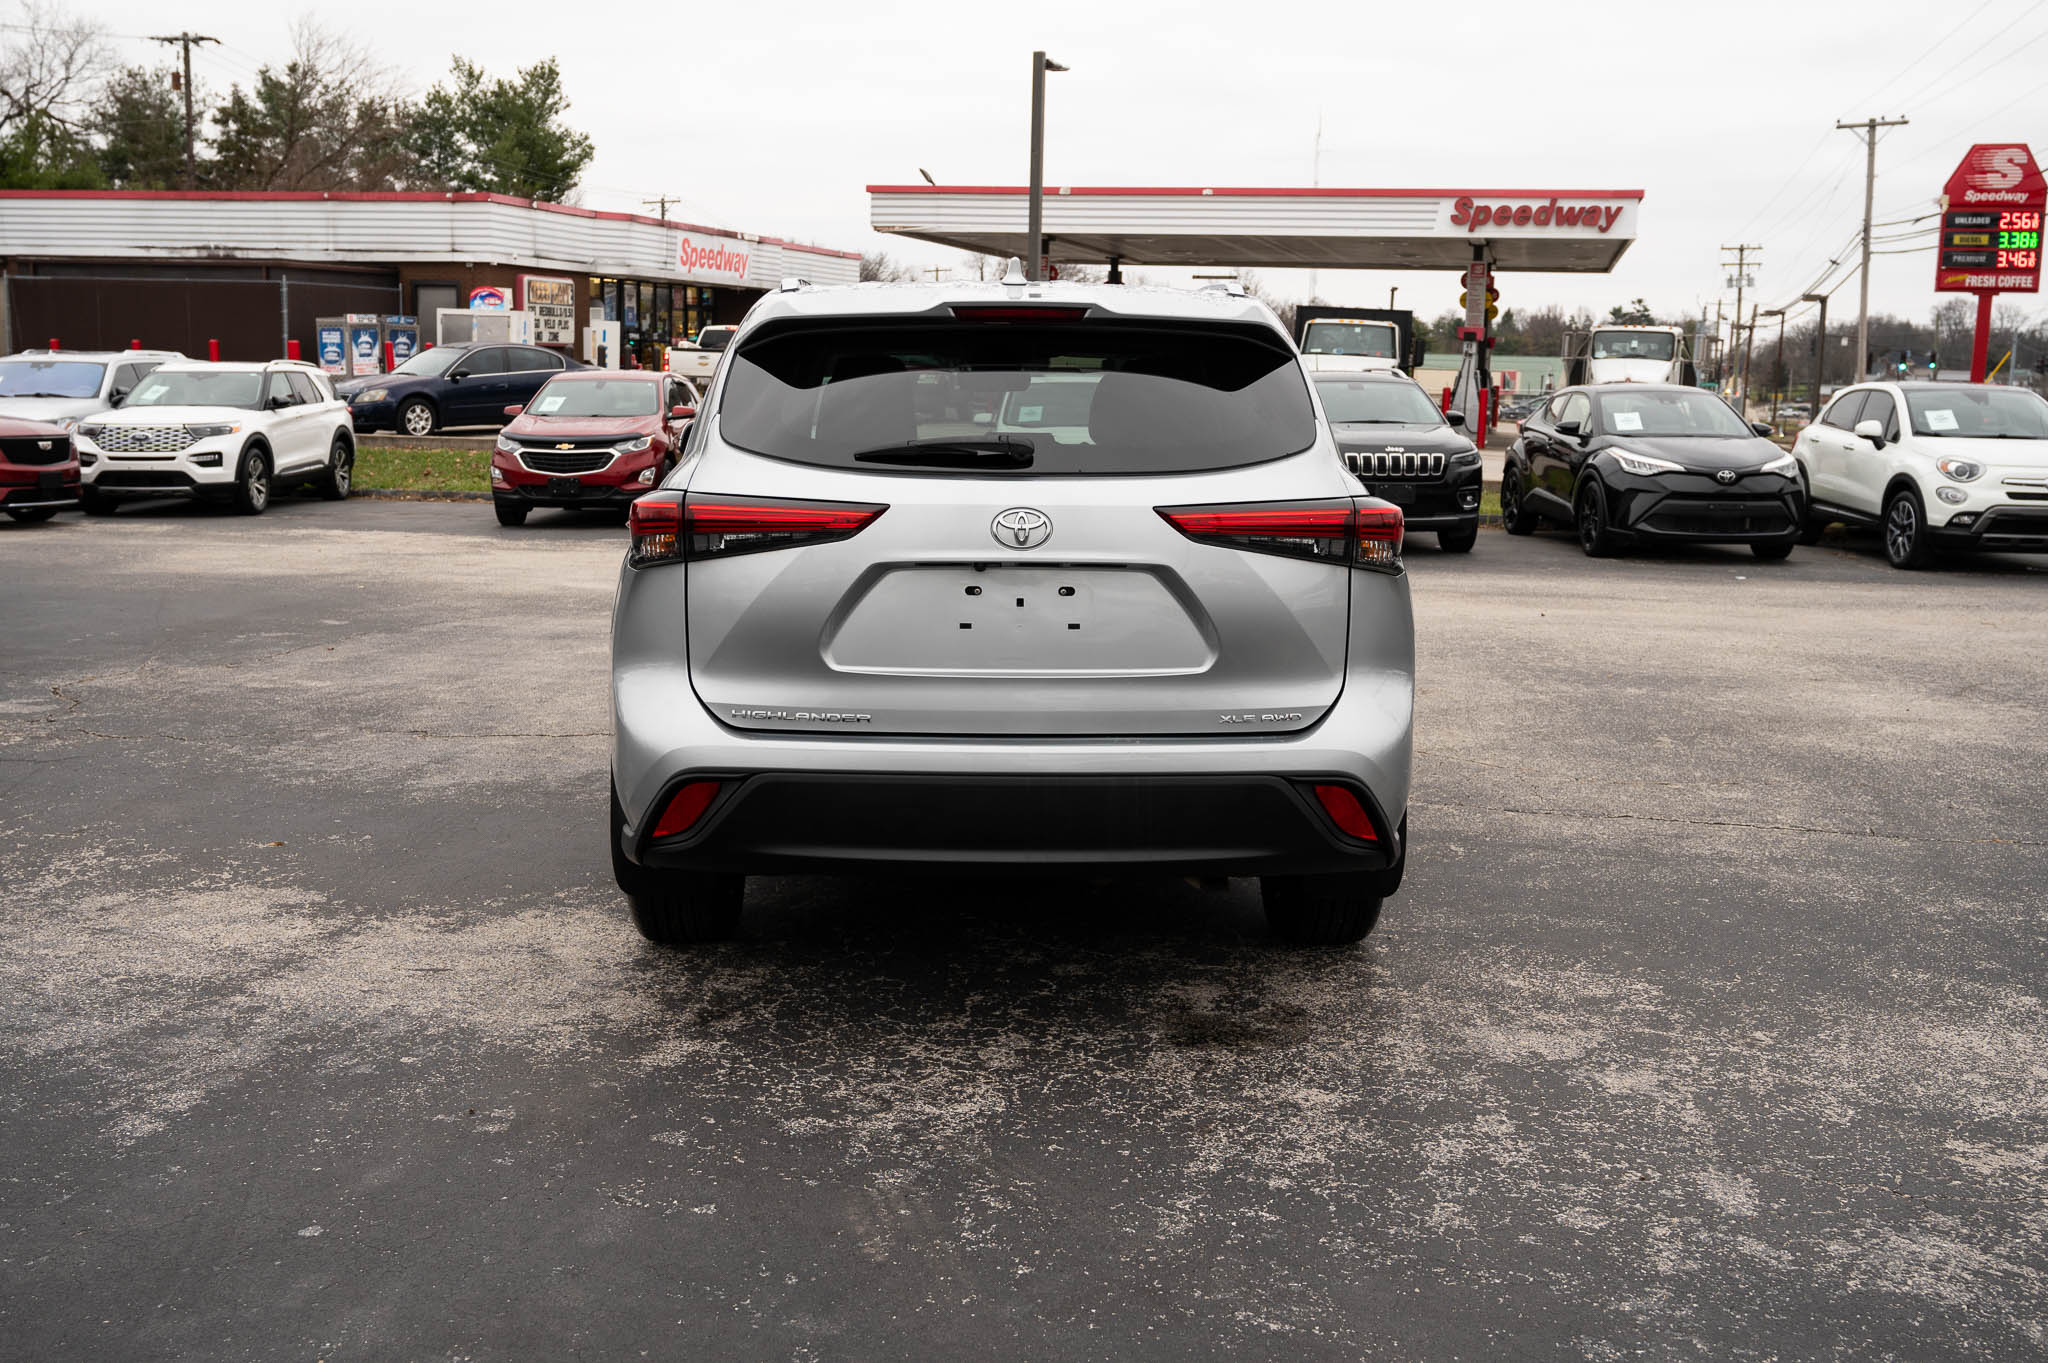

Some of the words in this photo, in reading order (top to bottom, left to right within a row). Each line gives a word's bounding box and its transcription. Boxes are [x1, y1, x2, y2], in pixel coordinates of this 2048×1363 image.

[1964, 190, 2029, 203] Speedway
[1450, 196, 1623, 233] Speedway
[1954, 216, 1991, 225] UNLEADED
[680, 237, 749, 279] Speedway
[1952, 255, 1987, 264] PREMIUM
[1965, 275, 1996, 288] FRESH
[1997, 275, 2034, 288] COFFEE
[731, 709, 872, 723] HIGHLANDER
[1220, 714, 1256, 724] XLE
[1261, 713, 1302, 722] AWD
